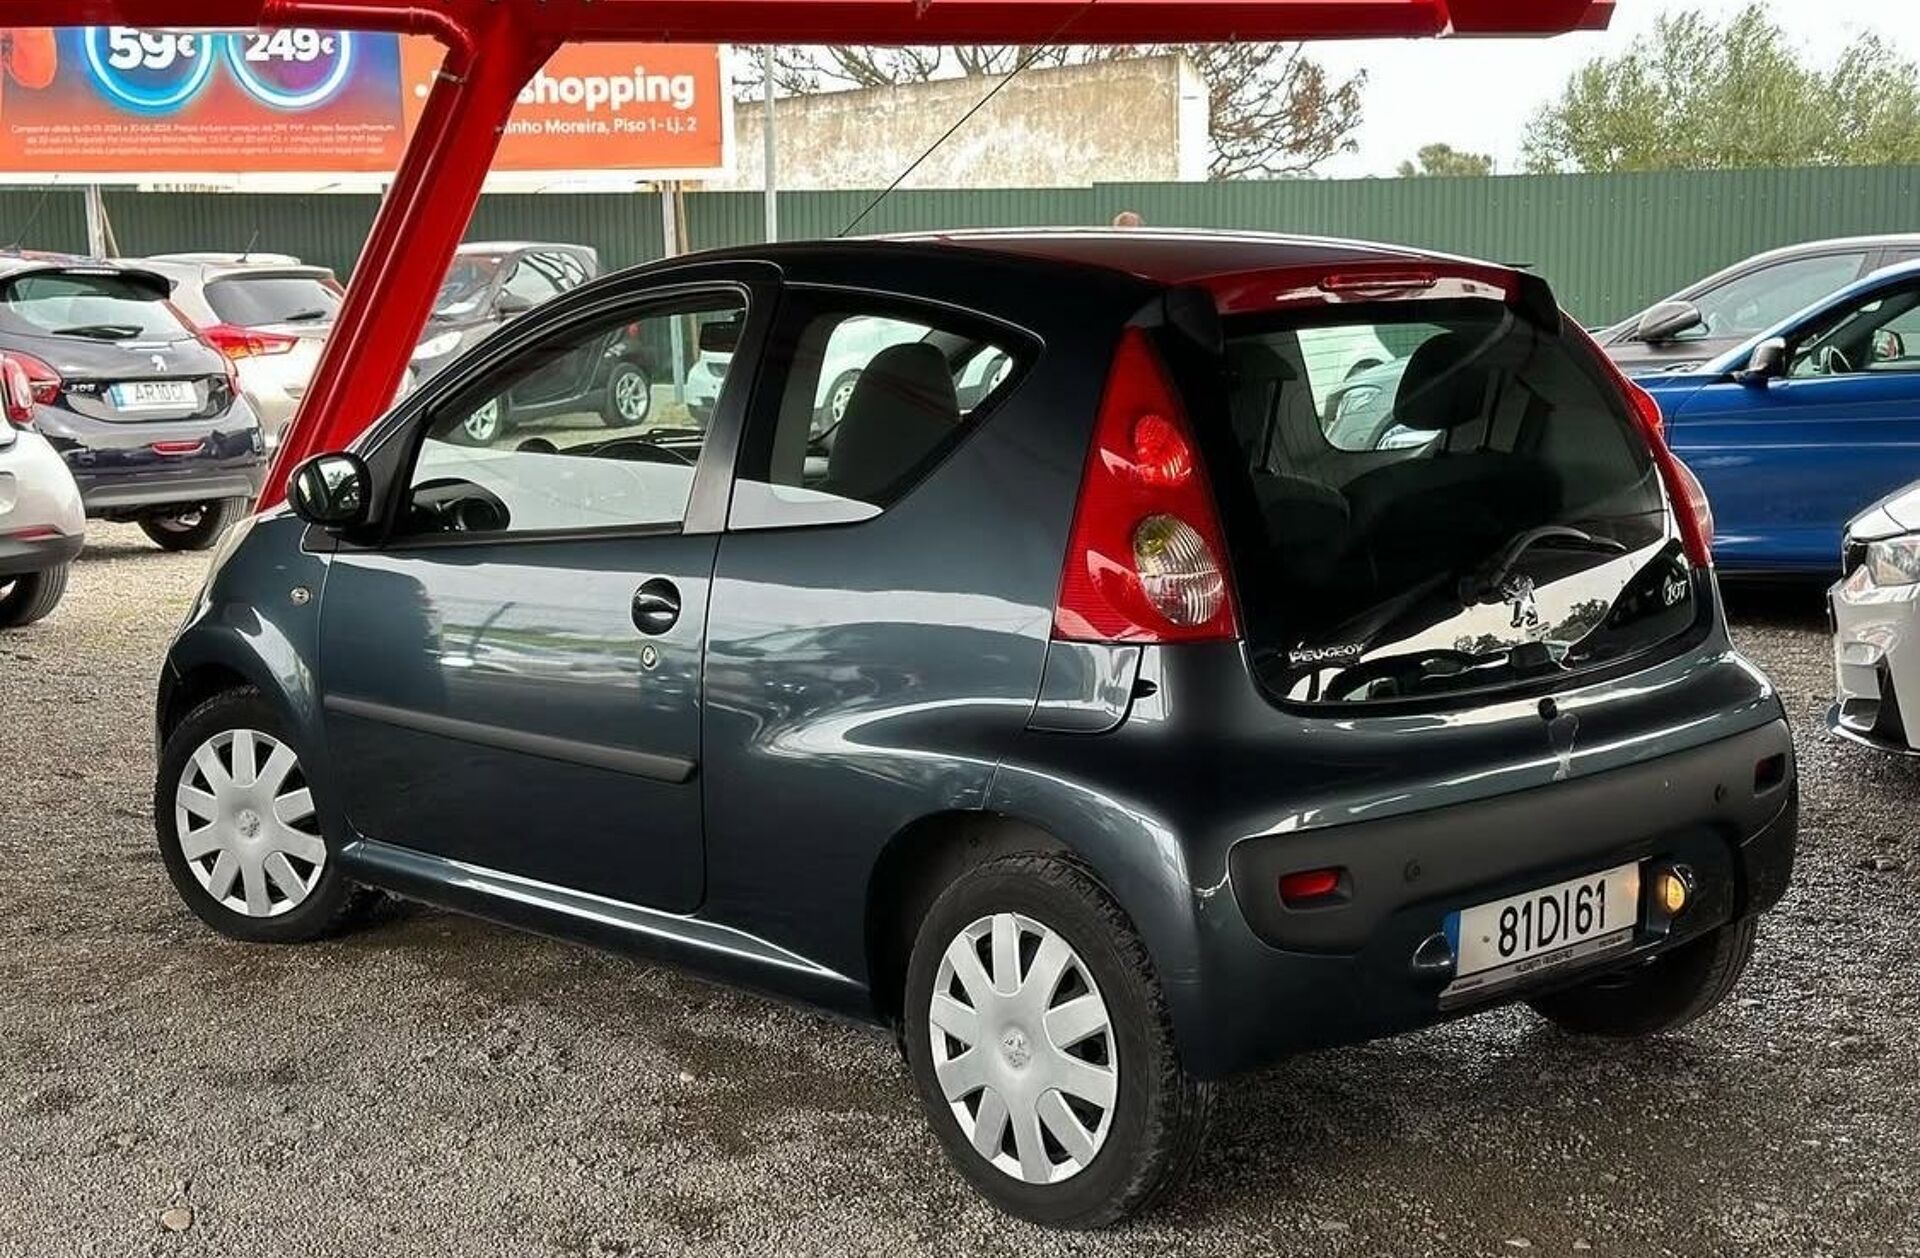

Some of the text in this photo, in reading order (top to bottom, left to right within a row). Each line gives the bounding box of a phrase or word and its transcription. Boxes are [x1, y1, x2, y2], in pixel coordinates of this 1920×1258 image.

[506, 119, 543, 134] inho
[613, 117, 646, 133] Piso
[1497, 879, 1607, 958] 81DI61
